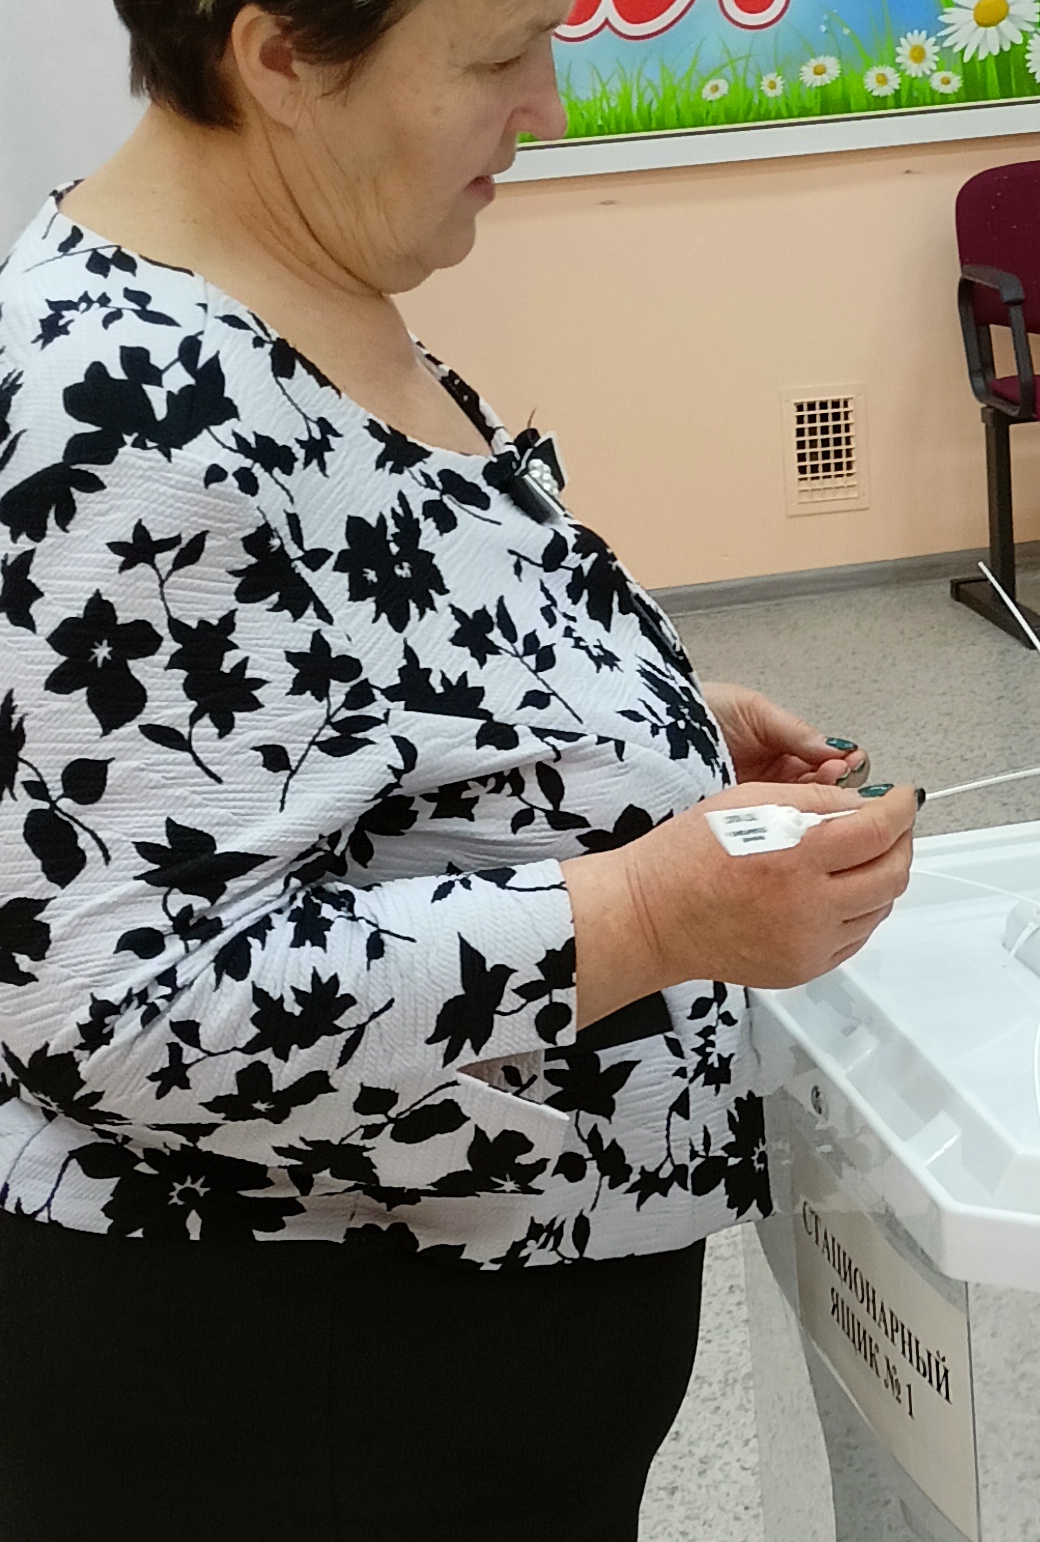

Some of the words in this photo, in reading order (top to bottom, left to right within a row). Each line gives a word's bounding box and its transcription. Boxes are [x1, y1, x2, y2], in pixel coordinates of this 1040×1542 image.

[802, 1200, 953, 1404] СТАЦИОНАРНЫЙ
[831, 1287, 881, 1379] ЯЩИК
[883, 1355, 902, 1404] №
[906, 1383, 914, 1419] 1
